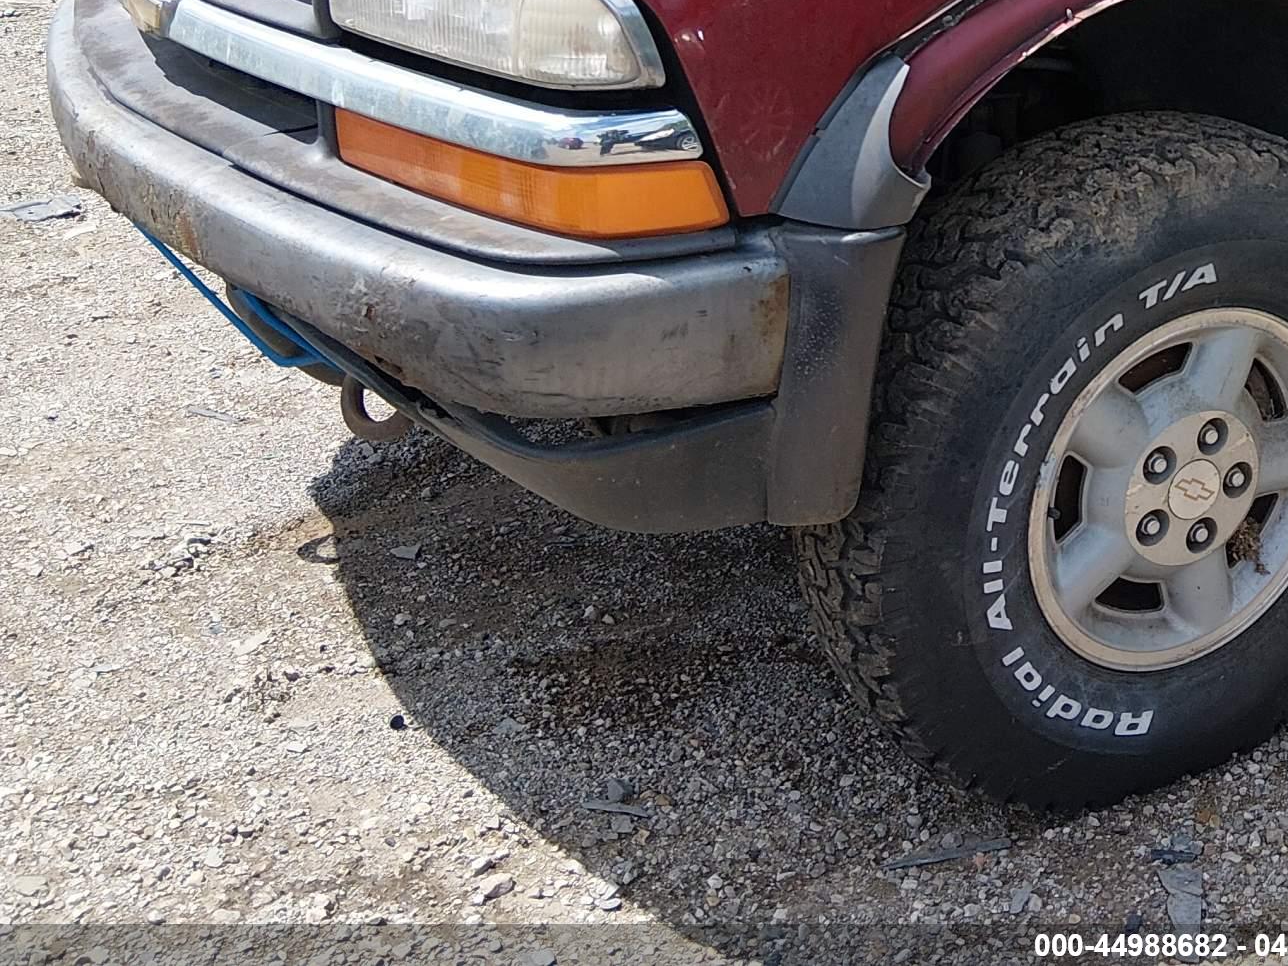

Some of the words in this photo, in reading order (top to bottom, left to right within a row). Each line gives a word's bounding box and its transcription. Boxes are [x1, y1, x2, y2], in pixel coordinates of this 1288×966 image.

[1137, 262, 1219, 311] T/A
[982, 312, 1126, 632] All-Terrain
[1001, 645, 1155, 737] Radial
